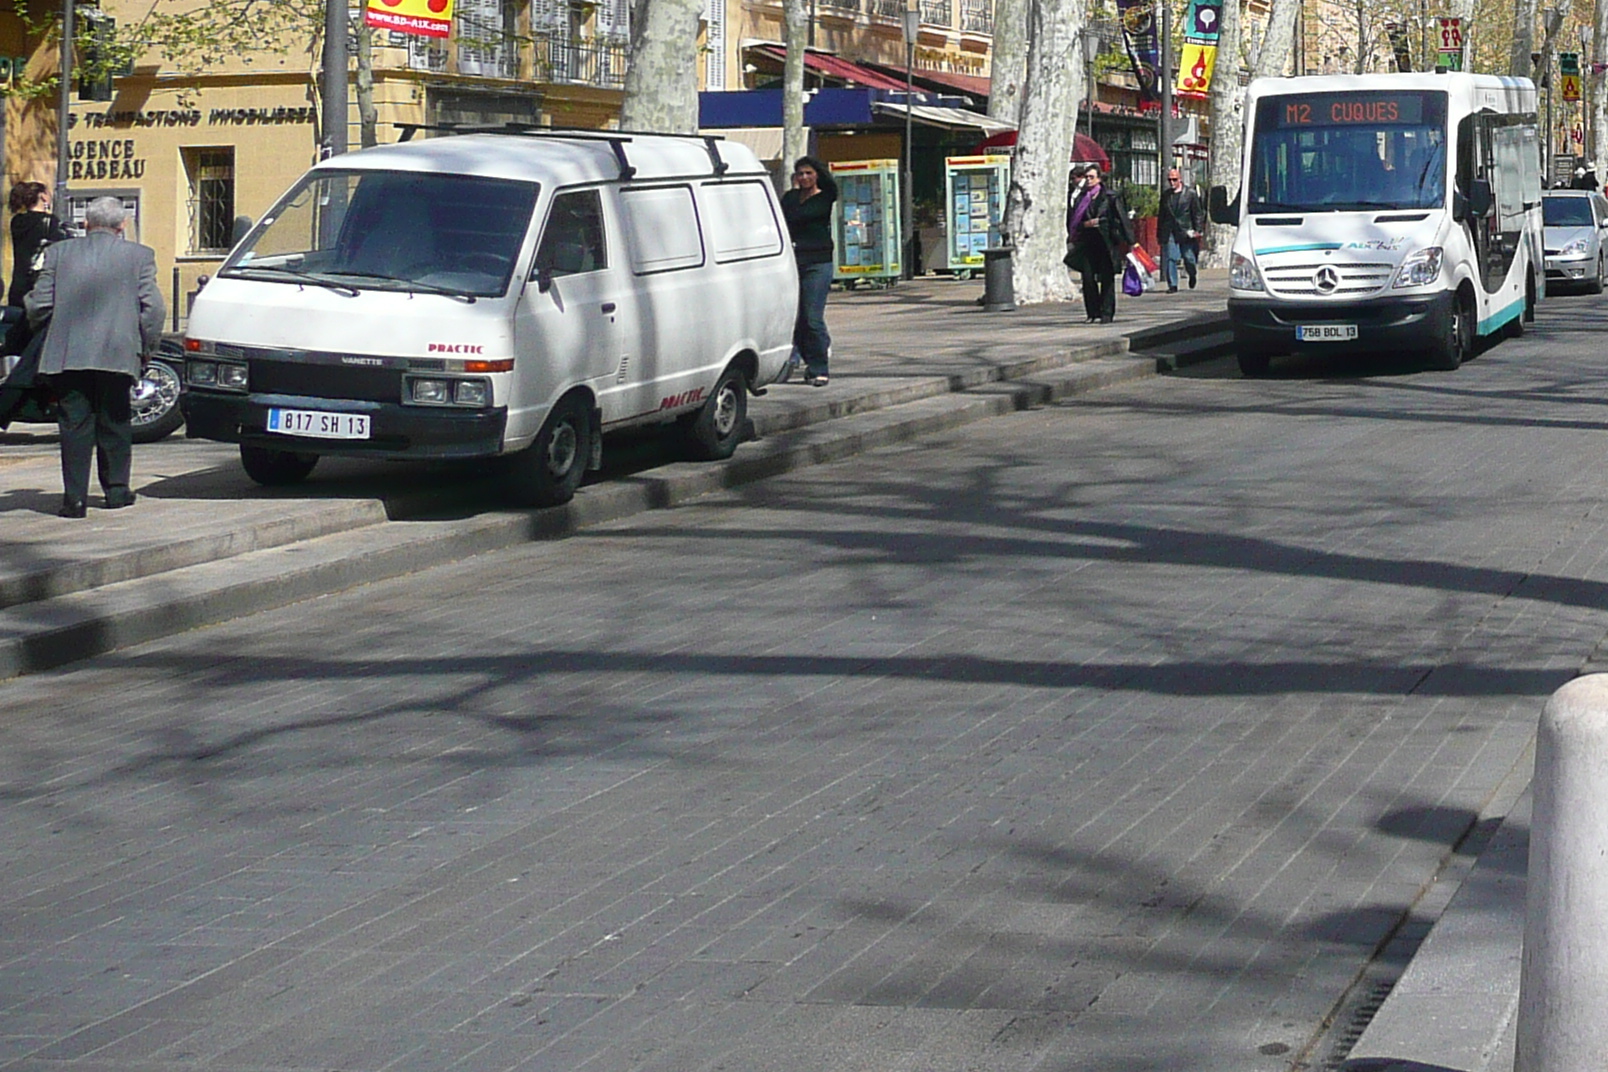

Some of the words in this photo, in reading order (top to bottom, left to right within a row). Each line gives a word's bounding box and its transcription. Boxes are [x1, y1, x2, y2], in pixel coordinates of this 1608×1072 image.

[84, 109, 202, 129] TRANSACTIONS
[1286, 103, 1312, 124] M2
[1331, 101, 1399, 123] CUQUES
[427, 343, 485, 354] PRACTIC
[285, 412, 313, 432] 817
[321, 415, 339, 433] SH
[349, 417, 365, 434] 13
